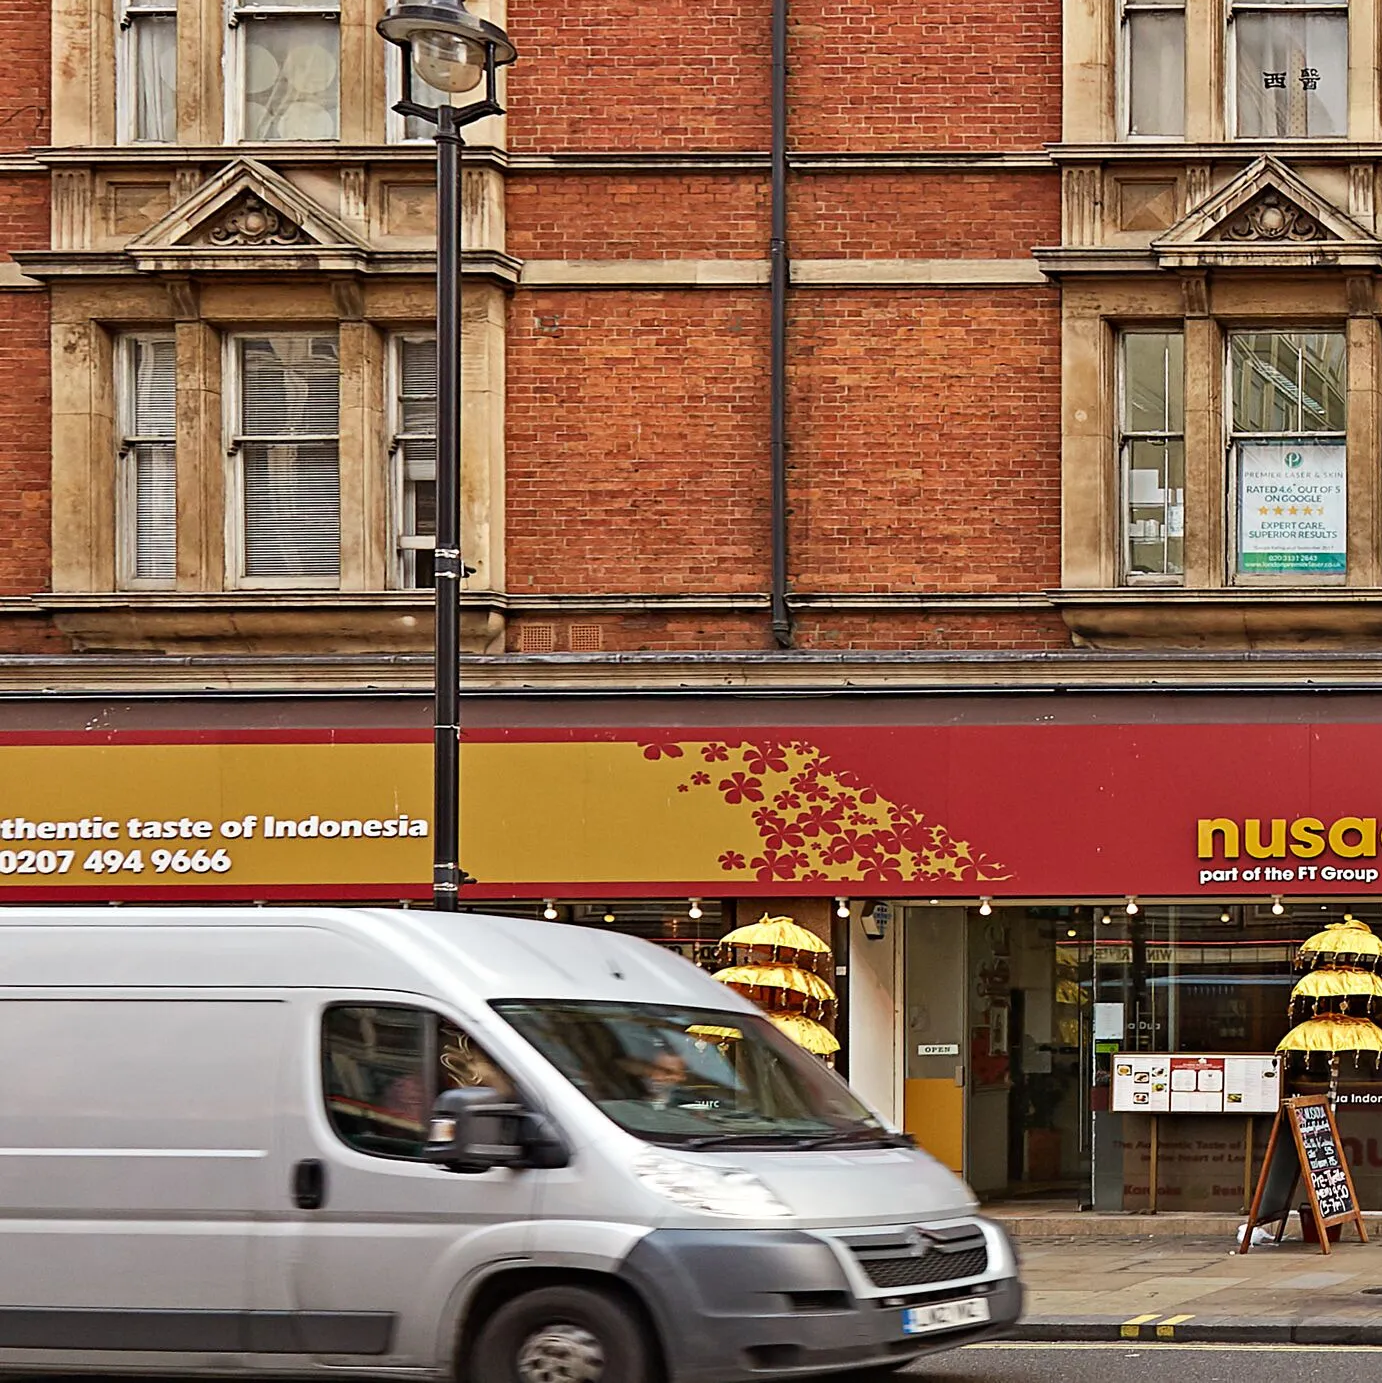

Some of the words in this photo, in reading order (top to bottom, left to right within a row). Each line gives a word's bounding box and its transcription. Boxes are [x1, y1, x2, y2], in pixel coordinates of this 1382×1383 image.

[1246, 485, 1277, 494] RATED
[1297, 485, 1318, 494] OUT
[1319, 485, 1332, 494] OF
[1264, 495, 1280, 503] ON
[1281, 495, 1321, 503] GOOGLE
[1261, 522, 1296, 530] EXPERT
[1248, 530, 1296, 539] SUPERIOR
[1298, 530, 1337, 539] RESULTS
[127, 817, 213, 840] taste
[219, 815, 257, 839] of
[263, 815, 429, 838] Indonesia
[0, 849, 75, 874] 0207
[83, 849, 144, 873] 494
[150, 848, 232, 873] 9666
[1199, 867, 1239, 884] part
[1241, 866, 1263, 881] of
[1265, 867, 1294, 881] the
[1297, 866, 1318, 881] FT
[1321, 867, 1379, 883] Group
